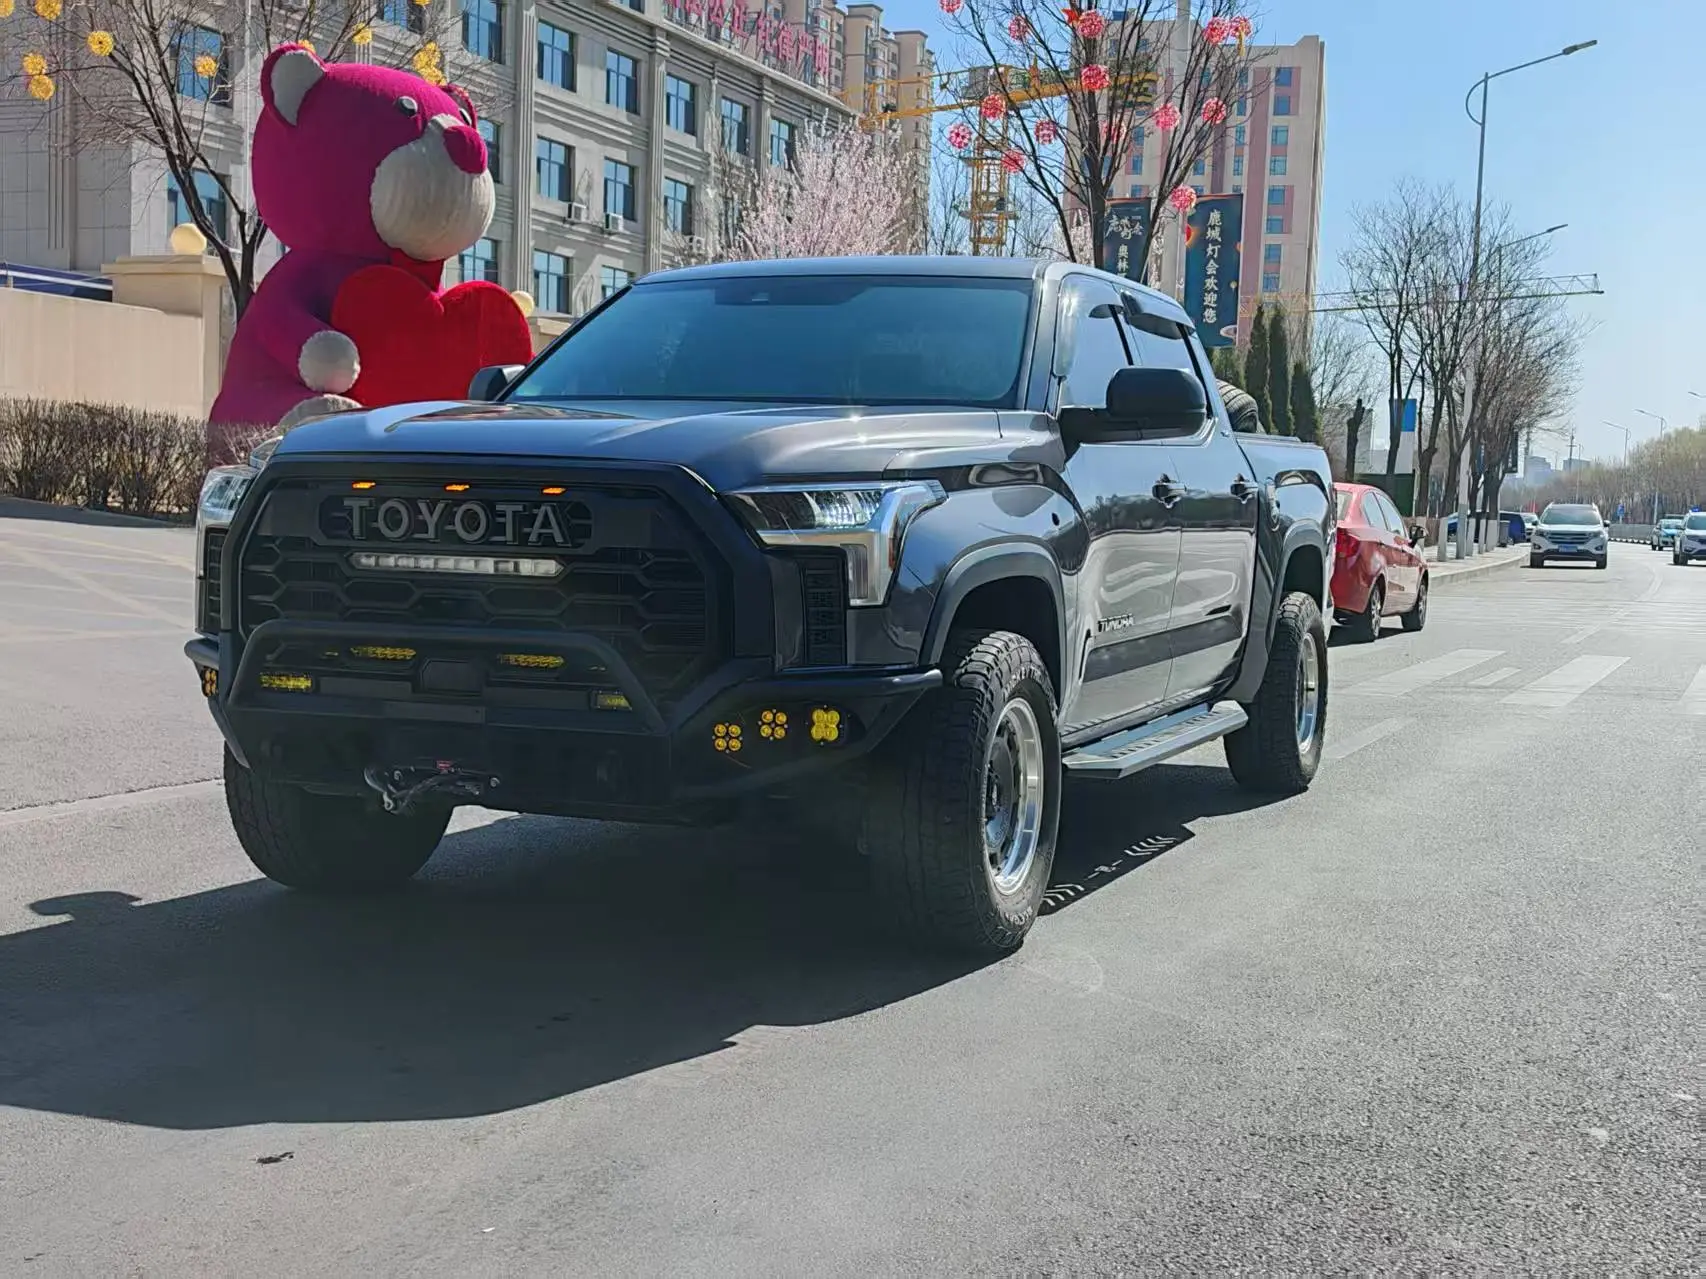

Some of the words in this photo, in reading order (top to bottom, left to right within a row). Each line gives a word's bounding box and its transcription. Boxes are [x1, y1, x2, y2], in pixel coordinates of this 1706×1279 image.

[1202, 208, 1222, 324] 鹿城灯会欢迎您
[343, 498, 570, 546] TOYOTA
[1098, 613, 1135, 632] TUNDRA
